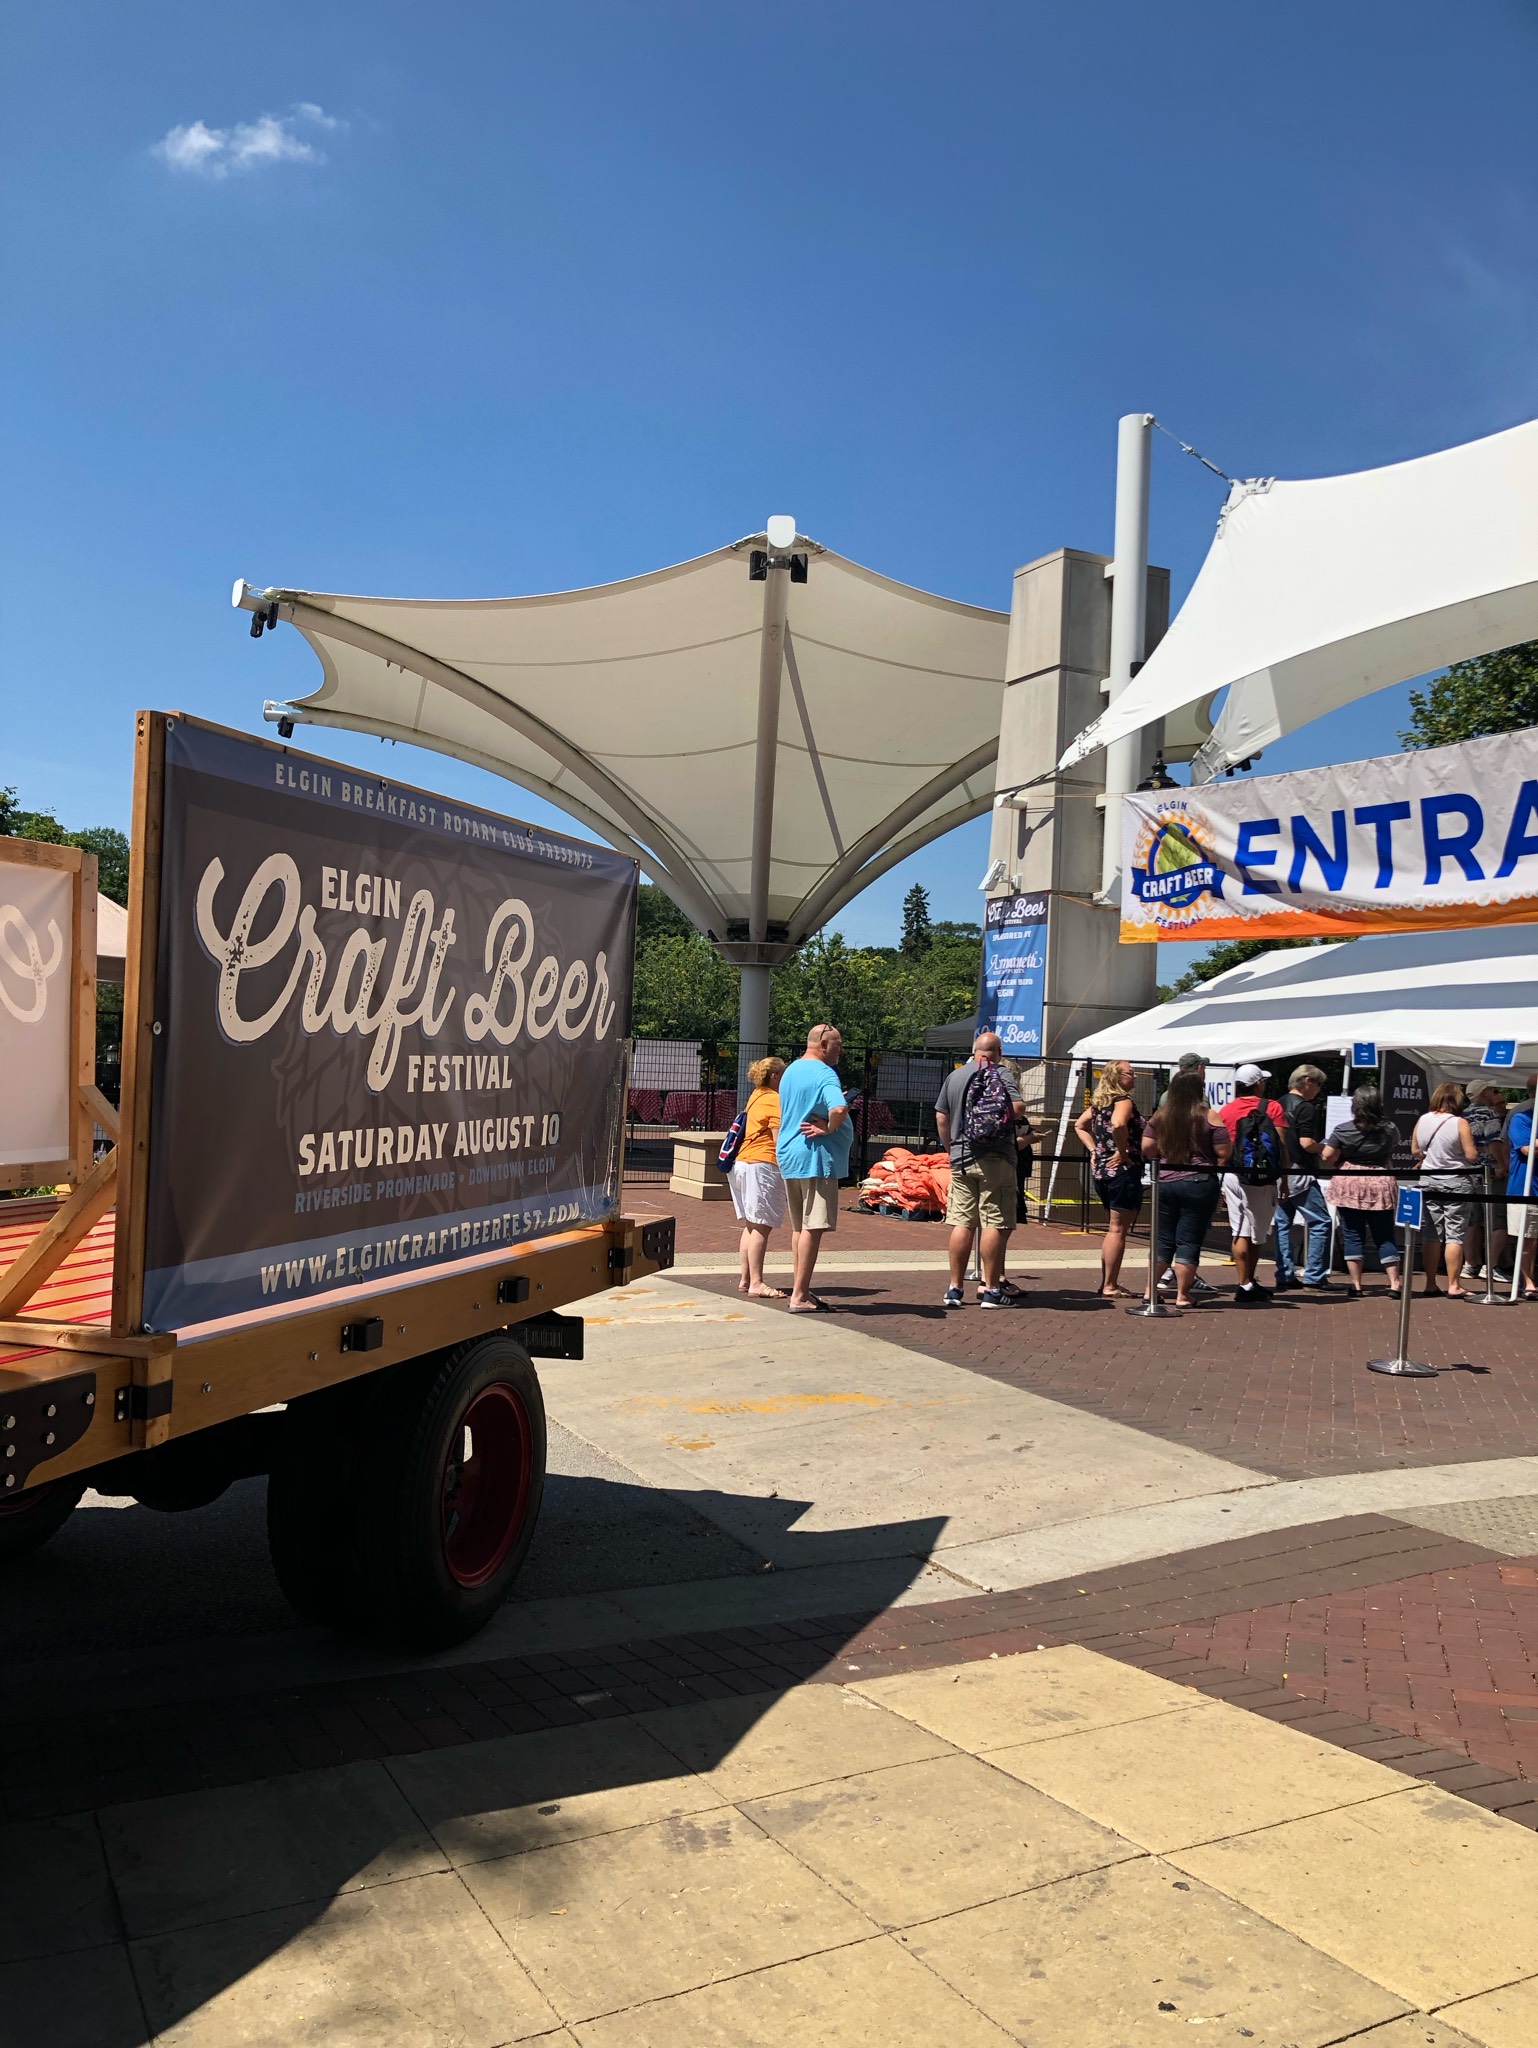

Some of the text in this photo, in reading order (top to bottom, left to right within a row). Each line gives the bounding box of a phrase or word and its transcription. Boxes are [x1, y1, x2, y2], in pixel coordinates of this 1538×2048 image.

[275, 763, 593, 869] ELGIN BREAKFAST ROTARY CLUB PRESENTS
[1157, 801, 1188, 813] ELGIN
[1234, 779, 1538, 895] ENTRA
[320, 866, 401, 919] ELGIN
[1142, 867, 1213, 898] CRAFT BEER
[1011, 898, 1047, 919] Beer
[1155, 915, 1203, 930] FESTIVAL
[196, 852, 457, 1094] Craft
[464, 898, 616, 1046] Beer
[1003, 1023, 1039, 1043] Beer
[407, 1055, 513, 1093] FESTIVAL
[1400, 1074, 1419, 1086] VIP
[1393, 1087, 1422, 1099] AREA
[298, 1112, 560, 1176] SATURDAY AUGUST 10
[295, 1156, 556, 1214] RIVERSIDE PROMENADE DOWNTOWN ELGIN
